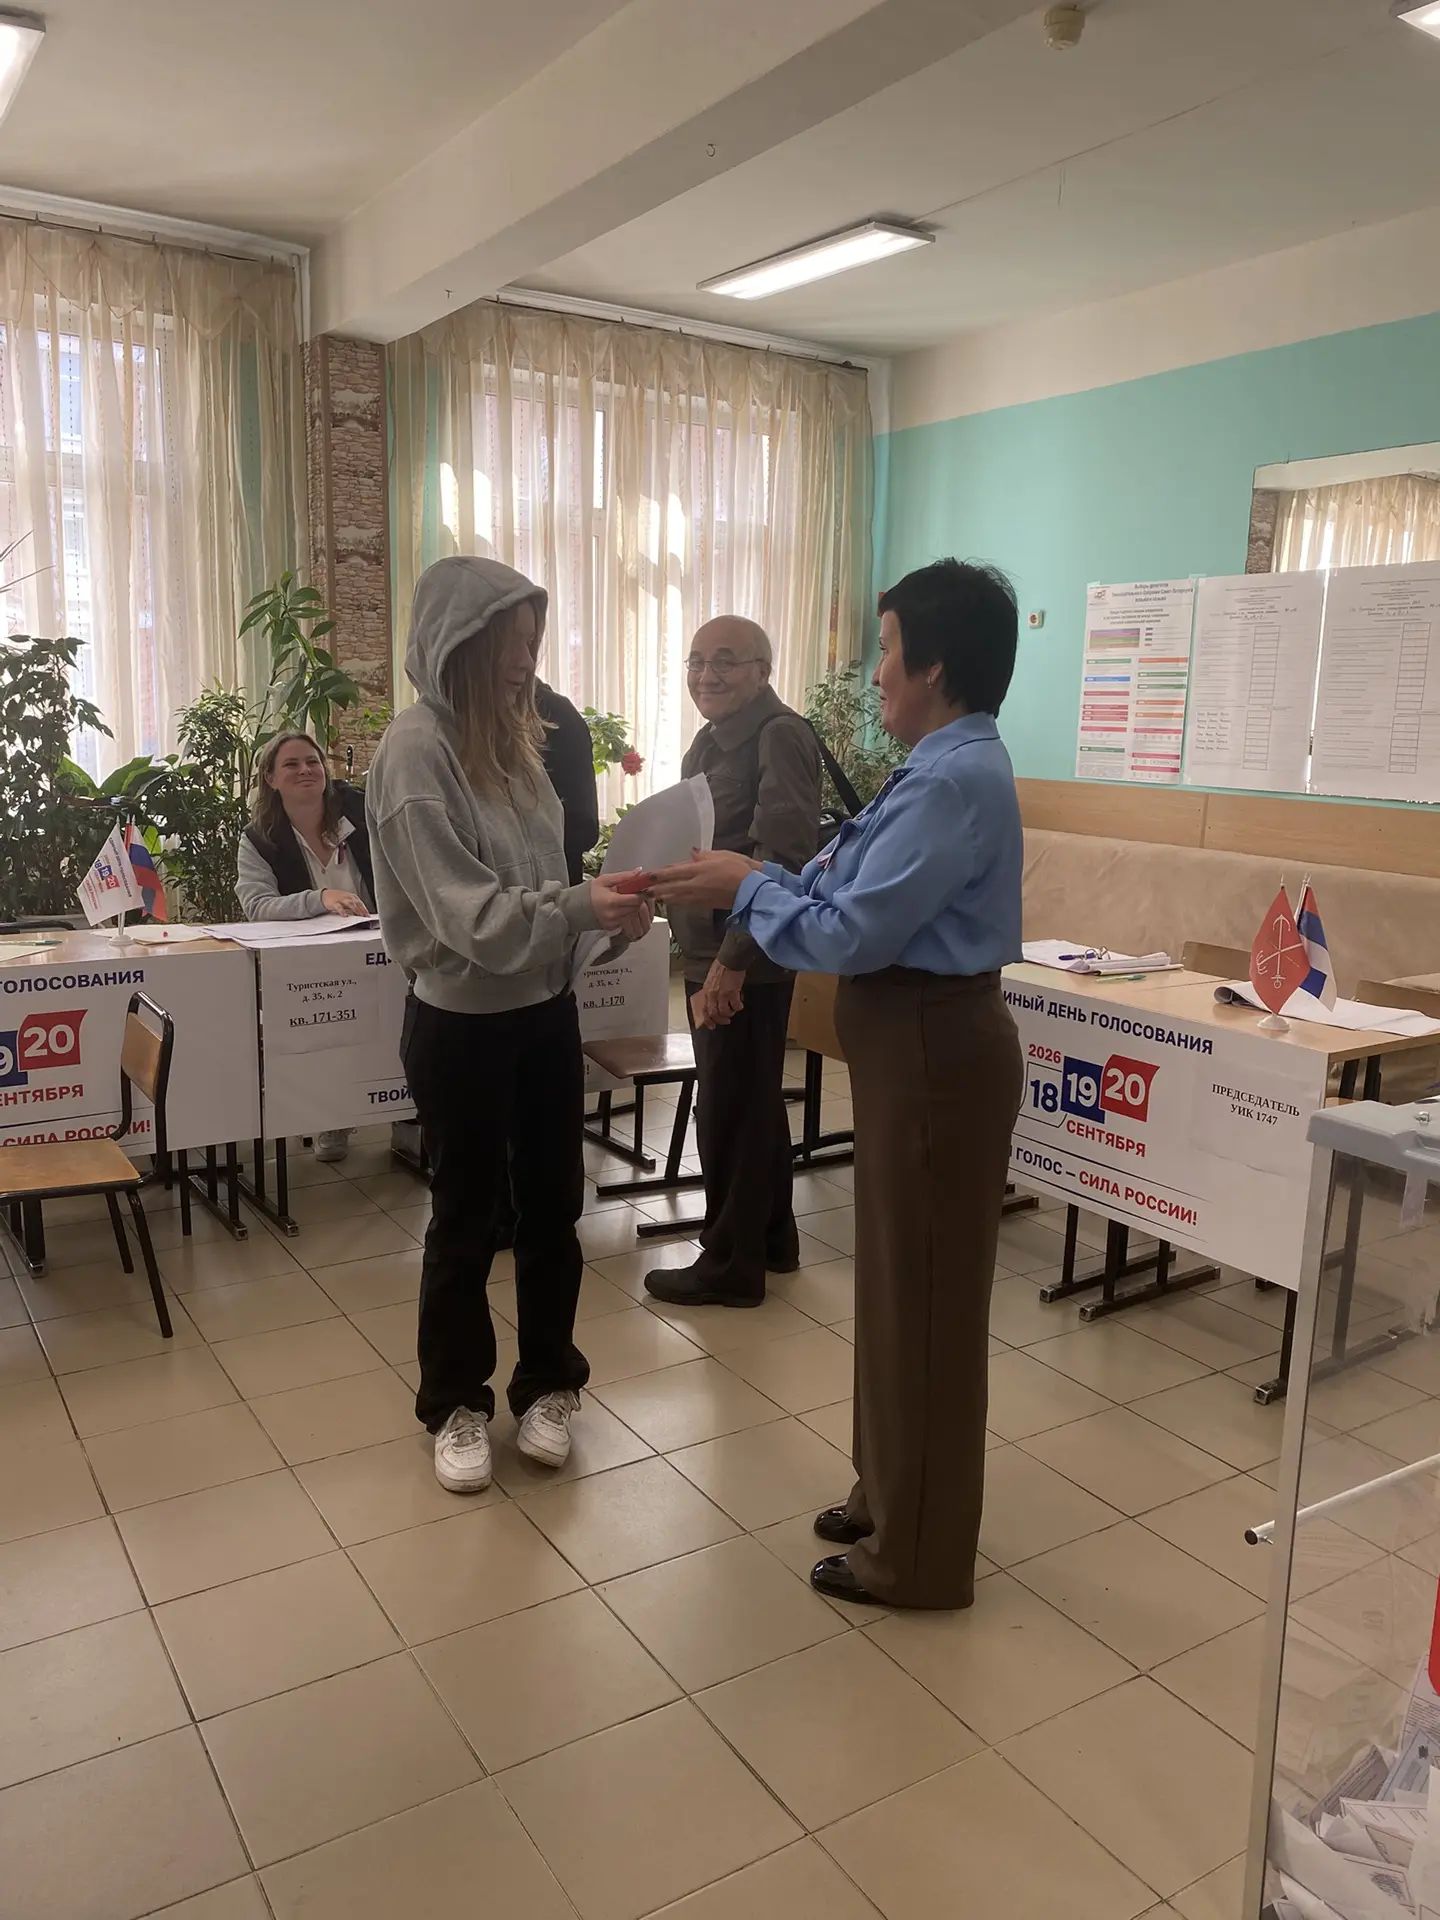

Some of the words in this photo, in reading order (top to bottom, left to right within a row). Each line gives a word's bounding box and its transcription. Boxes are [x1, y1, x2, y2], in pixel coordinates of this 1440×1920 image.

[102, 867, 109, 877] 19
[108, 876, 116, 887] 20
[366, 952, 392, 966] ЕД
[0, 970, 144, 994] ОЛОСОВАНИЯ
[287, 980, 340, 992] Туристская
[302, 995, 310, 1003] д.
[311, 992, 325, 1001] 35,
[327, 992, 336, 1000] к.
[600, 996, 625, 1008] 1-170
[289, 1017, 309, 1027] кв.
[312, 1009, 357, 1023] 171-351
[1047, 1001, 1087, 1023] ДЕНЬ
[1090, 1011, 1213, 1055] ГОЛОСОВАНИЯ
[23, 1024, 74, 1058] 20
[1028, 1044, 1061, 1064] 2026
[368, 1085, 411, 1104] ТВОЙ
[1030, 1079, 1058, 1113] 18
[1066, 1072, 1097, 1107] 19
[1104, 1068, 1146, 1106] 20
[1212, 1083, 1300, 1117] ПРЕДСЕДАТЕЛЬ
[1230, 1104, 1254, 1119] УИК
[1256, 1111, 1278, 1125] 1747
[65, 1119, 151, 1141] РОССИ!
[1066, 1120, 1146, 1158] СЕНТЯБРЯ
[1016, 1147, 1062, 1175] ГОЛОС
[1079, 1171, 1120, 1198] СИЛА
[1124, 1186, 1197, 1226] РОССИИ!
